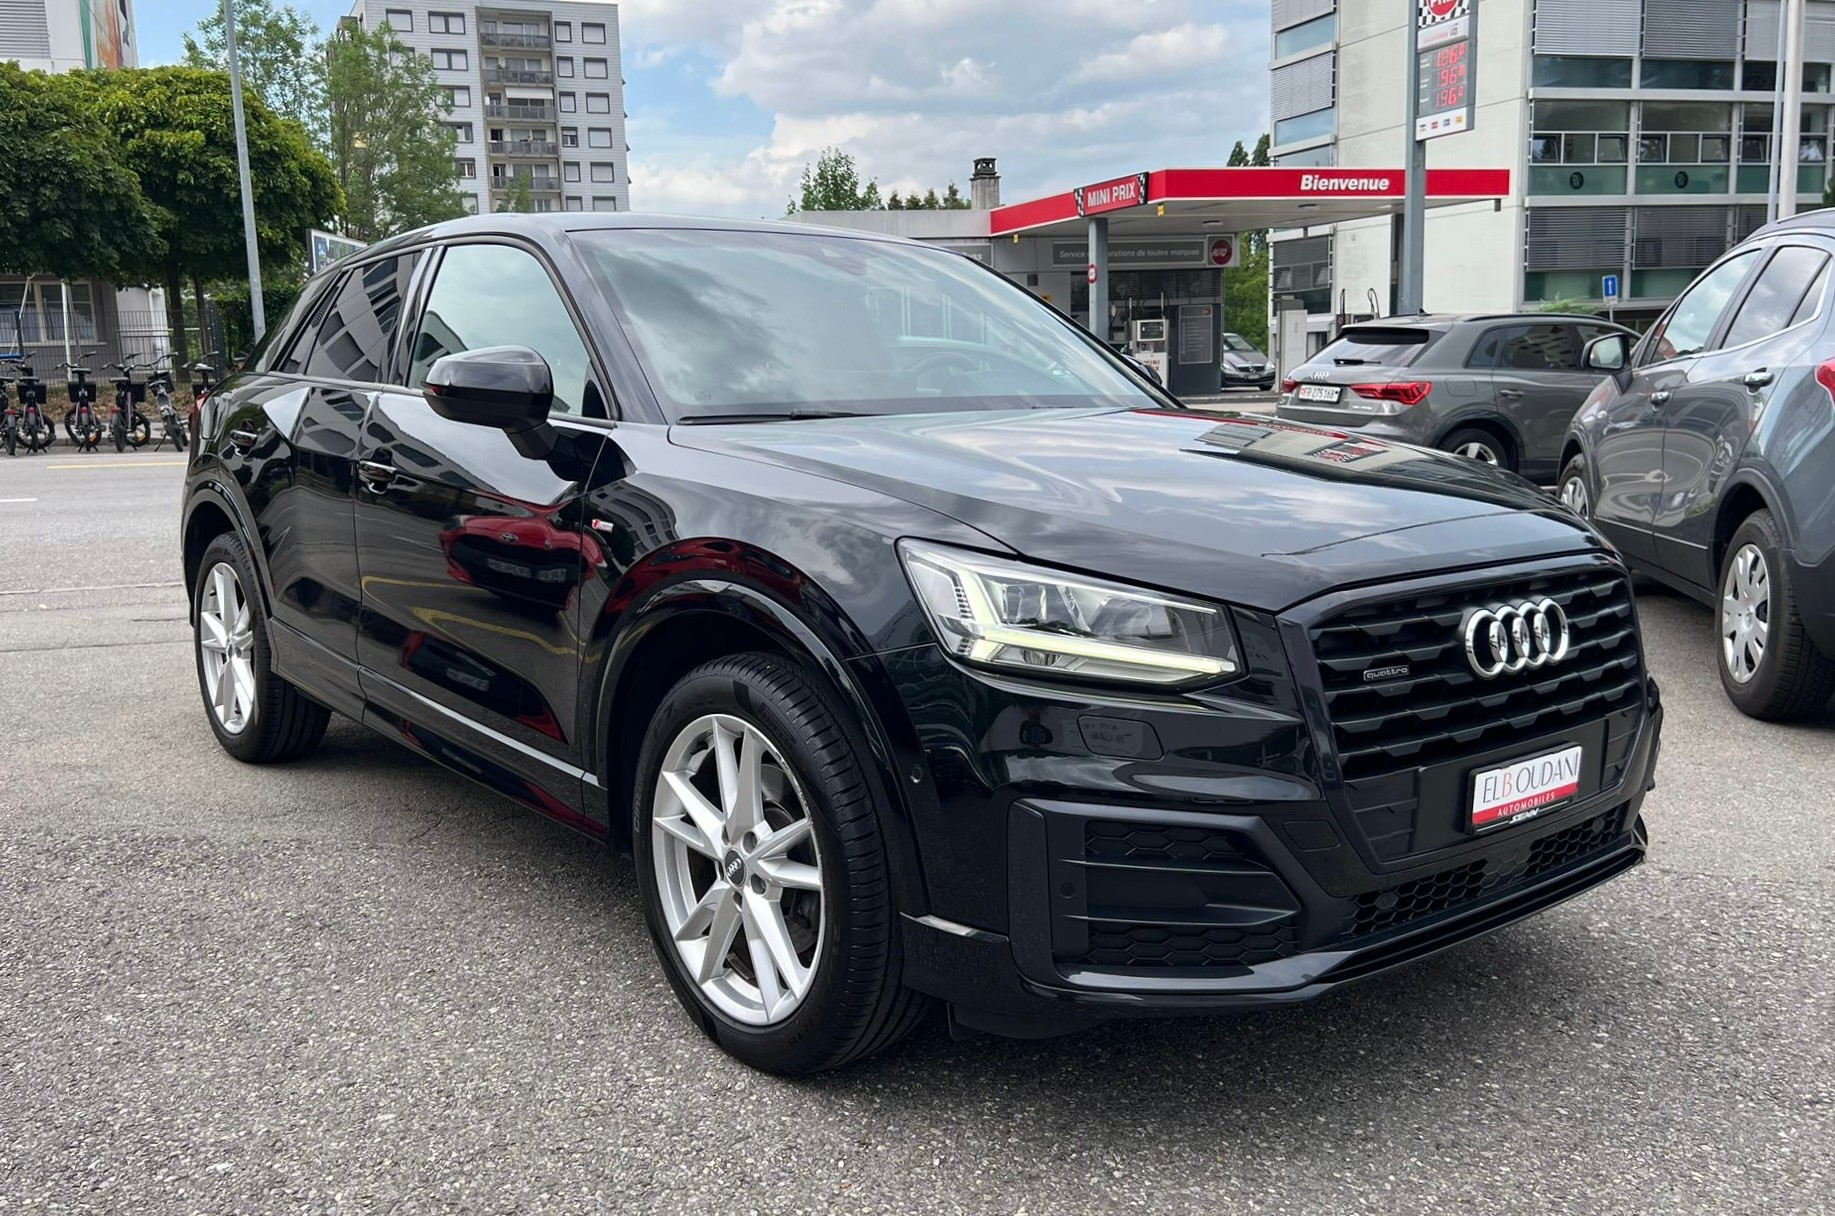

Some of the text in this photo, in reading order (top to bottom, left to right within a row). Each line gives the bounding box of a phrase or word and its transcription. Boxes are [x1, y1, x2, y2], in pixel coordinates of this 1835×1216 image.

[1300, 175, 1389, 191] Bienvenue
[1087, 182, 1136, 208] MINI PRIX
[1366, 667, 1408, 679] quattro
[1497, 792, 1555, 817] AUTOMOBILES
